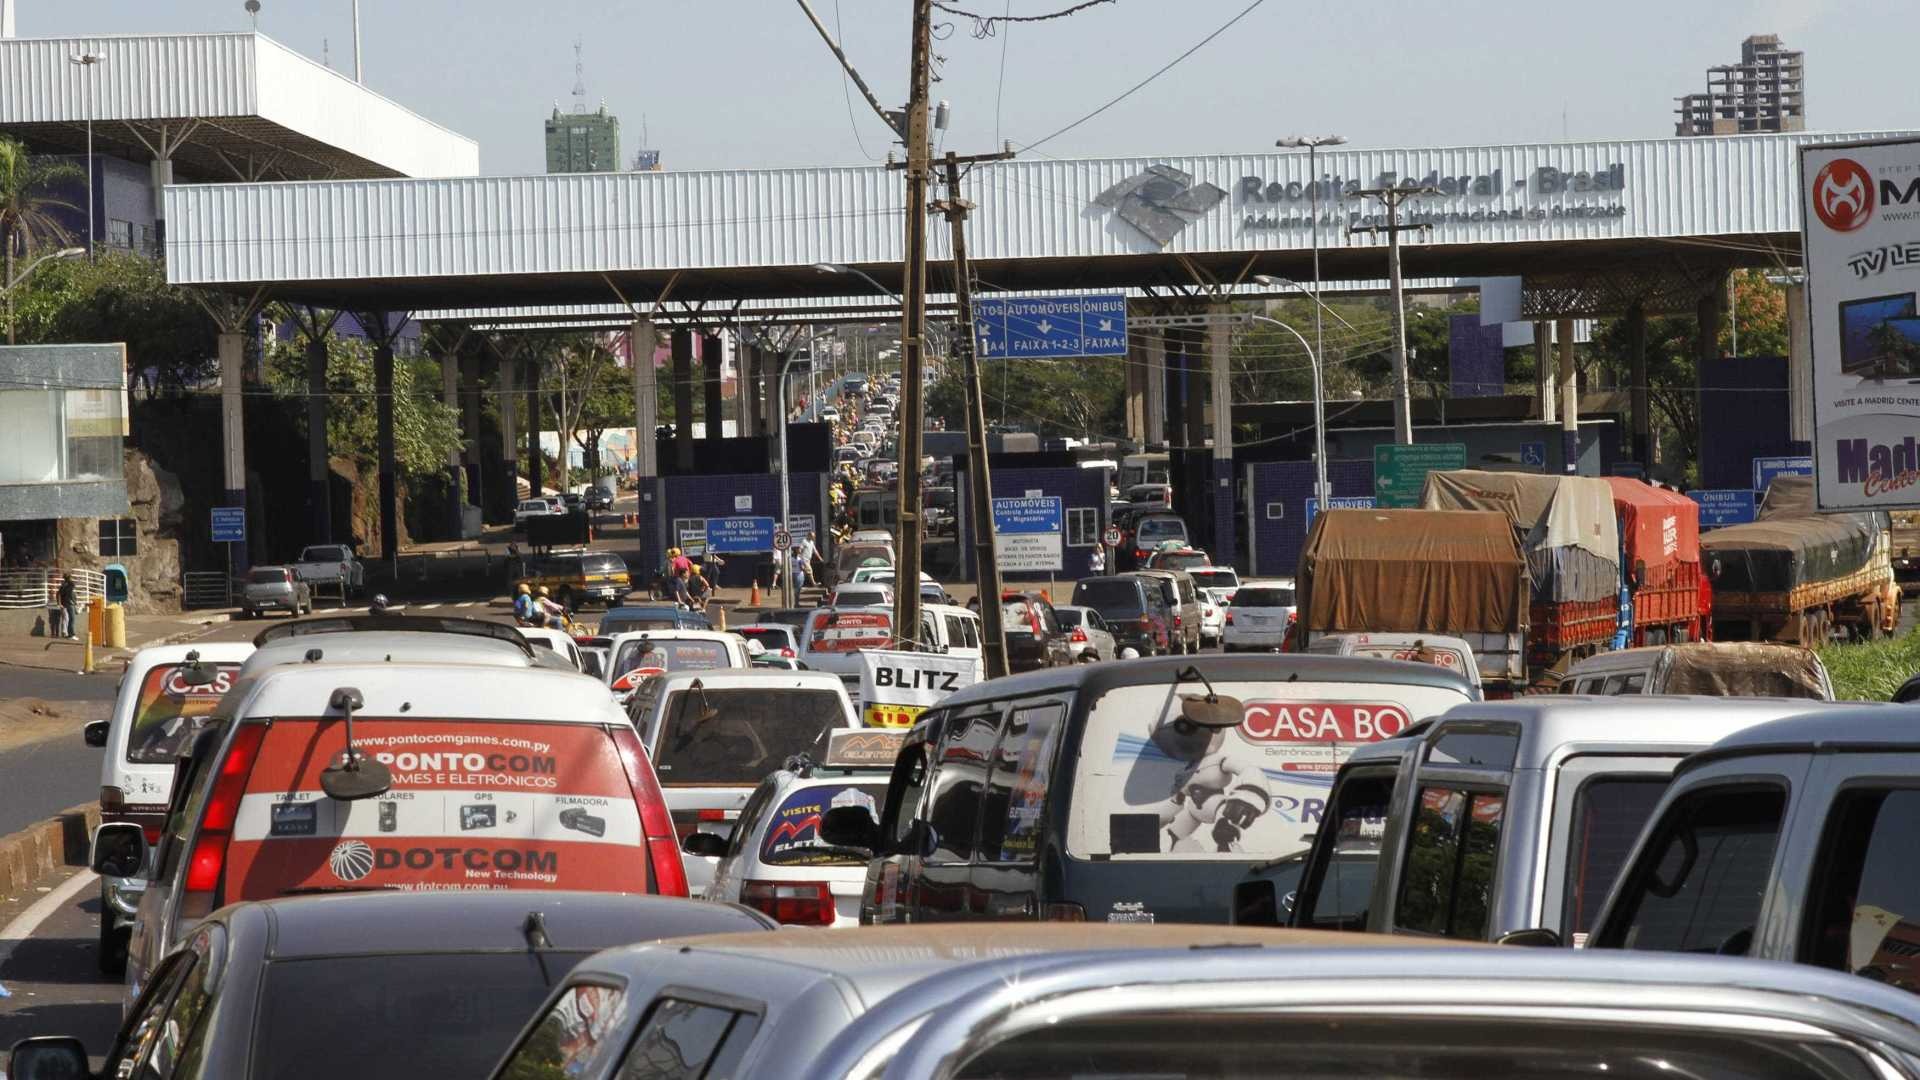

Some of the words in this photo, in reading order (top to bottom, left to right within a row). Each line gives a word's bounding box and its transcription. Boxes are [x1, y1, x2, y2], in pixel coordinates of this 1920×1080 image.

[1242, 174, 1361, 200] Receita
[1538, 163, 1625, 194] Brasil
[1244, 214, 1313, 229] Aduana
[1350, 211, 1402, 224] Pone
[1083, 301, 1124, 312] ÔNIBUS
[1014, 340, 1049, 350] FAIXA
[1052, 339, 1079, 349] 1-2-3
[1865, 397, 1895, 405] MADRID
[997, 499, 1056, 509] AUTOMÓVEIS
[1313, 500, 1372, 509] ATOMÓVEIS
[725, 521, 755, 529] MOTOS
[776, 534, 788, 544] 20
[1107, 531, 1119, 540] 20
[876, 667, 959, 692] BLITZ
[1243, 706, 1344, 739] CASA
[1353, 708, 1405, 740] BO
[350, 733, 551, 753] www.pontocomgames.com.py
[1264, 747, 1323, 757] Eletrônicos
[436, 774, 445, 785] E
[449, 772, 557, 788] ELETRÔNICOS
[474, 792, 493, 801] GPS
[555, 797, 609, 807] FILMADORA
[782, 805, 822, 817] VISITE
[377, 847, 558, 871] DOTCOM
[465, 869, 492, 879] New
[494, 869, 558, 882] Technology
